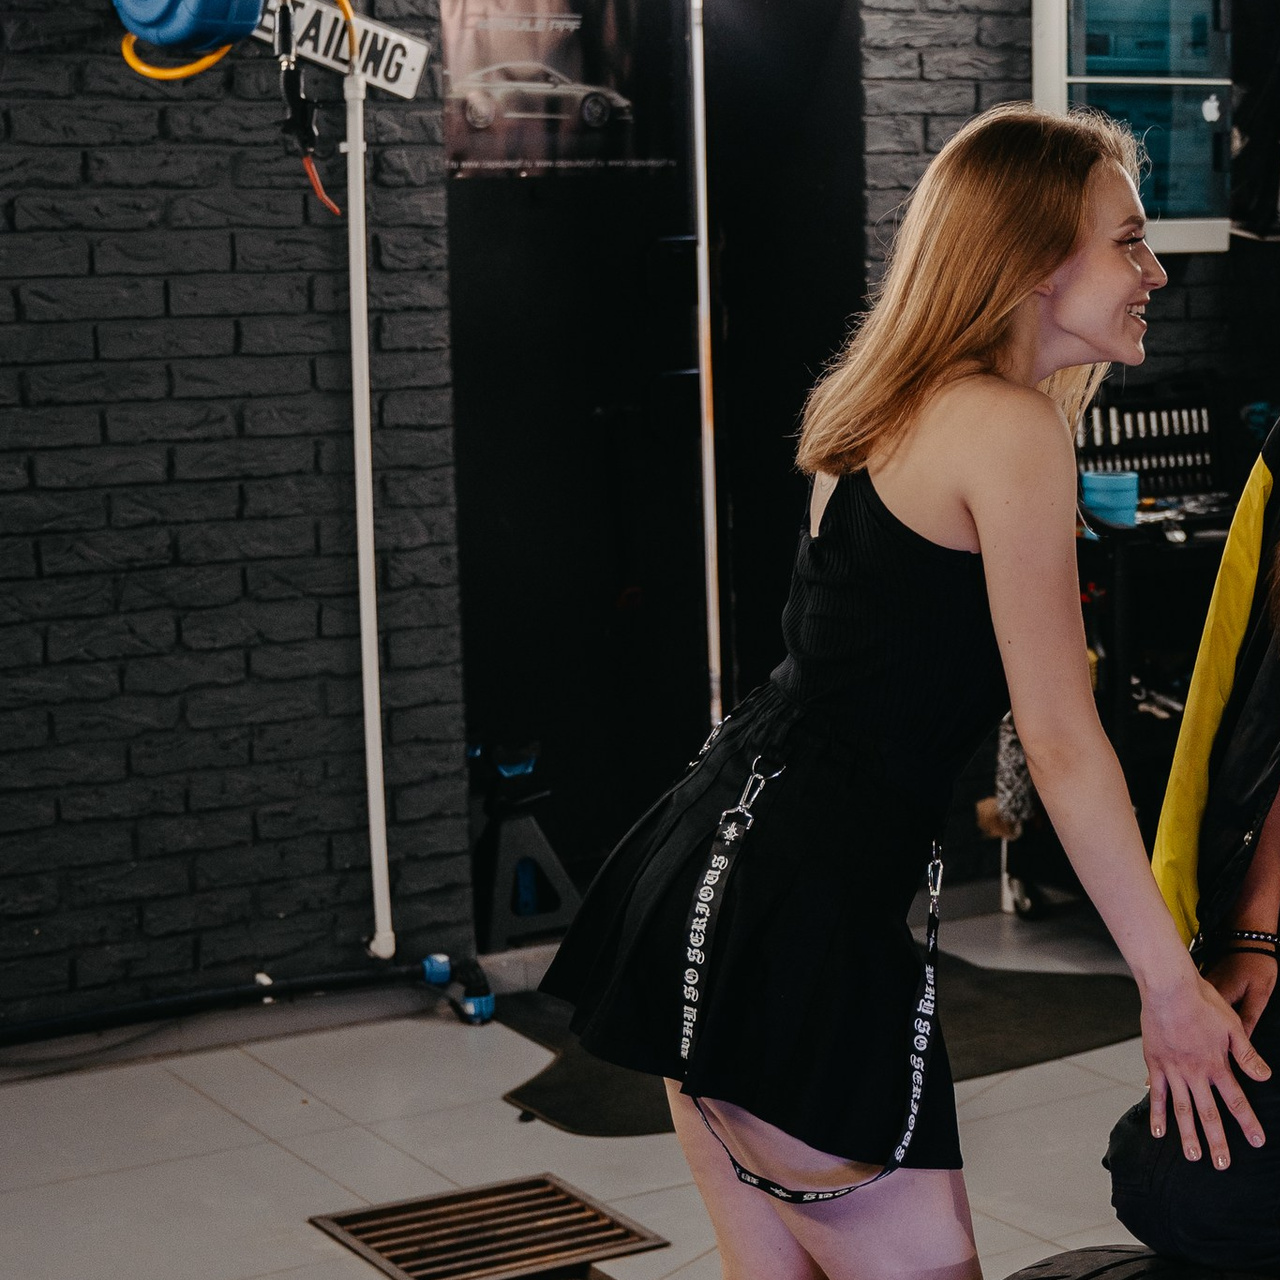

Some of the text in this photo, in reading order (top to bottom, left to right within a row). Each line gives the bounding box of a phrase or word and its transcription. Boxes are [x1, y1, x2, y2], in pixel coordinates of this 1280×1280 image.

[686, 853, 728, 966] SERIOUS
[682, 967, 700, 1003] SO
[914, 1017, 931, 1051] SO
[894, 1053, 926, 1163] SERIOUS
